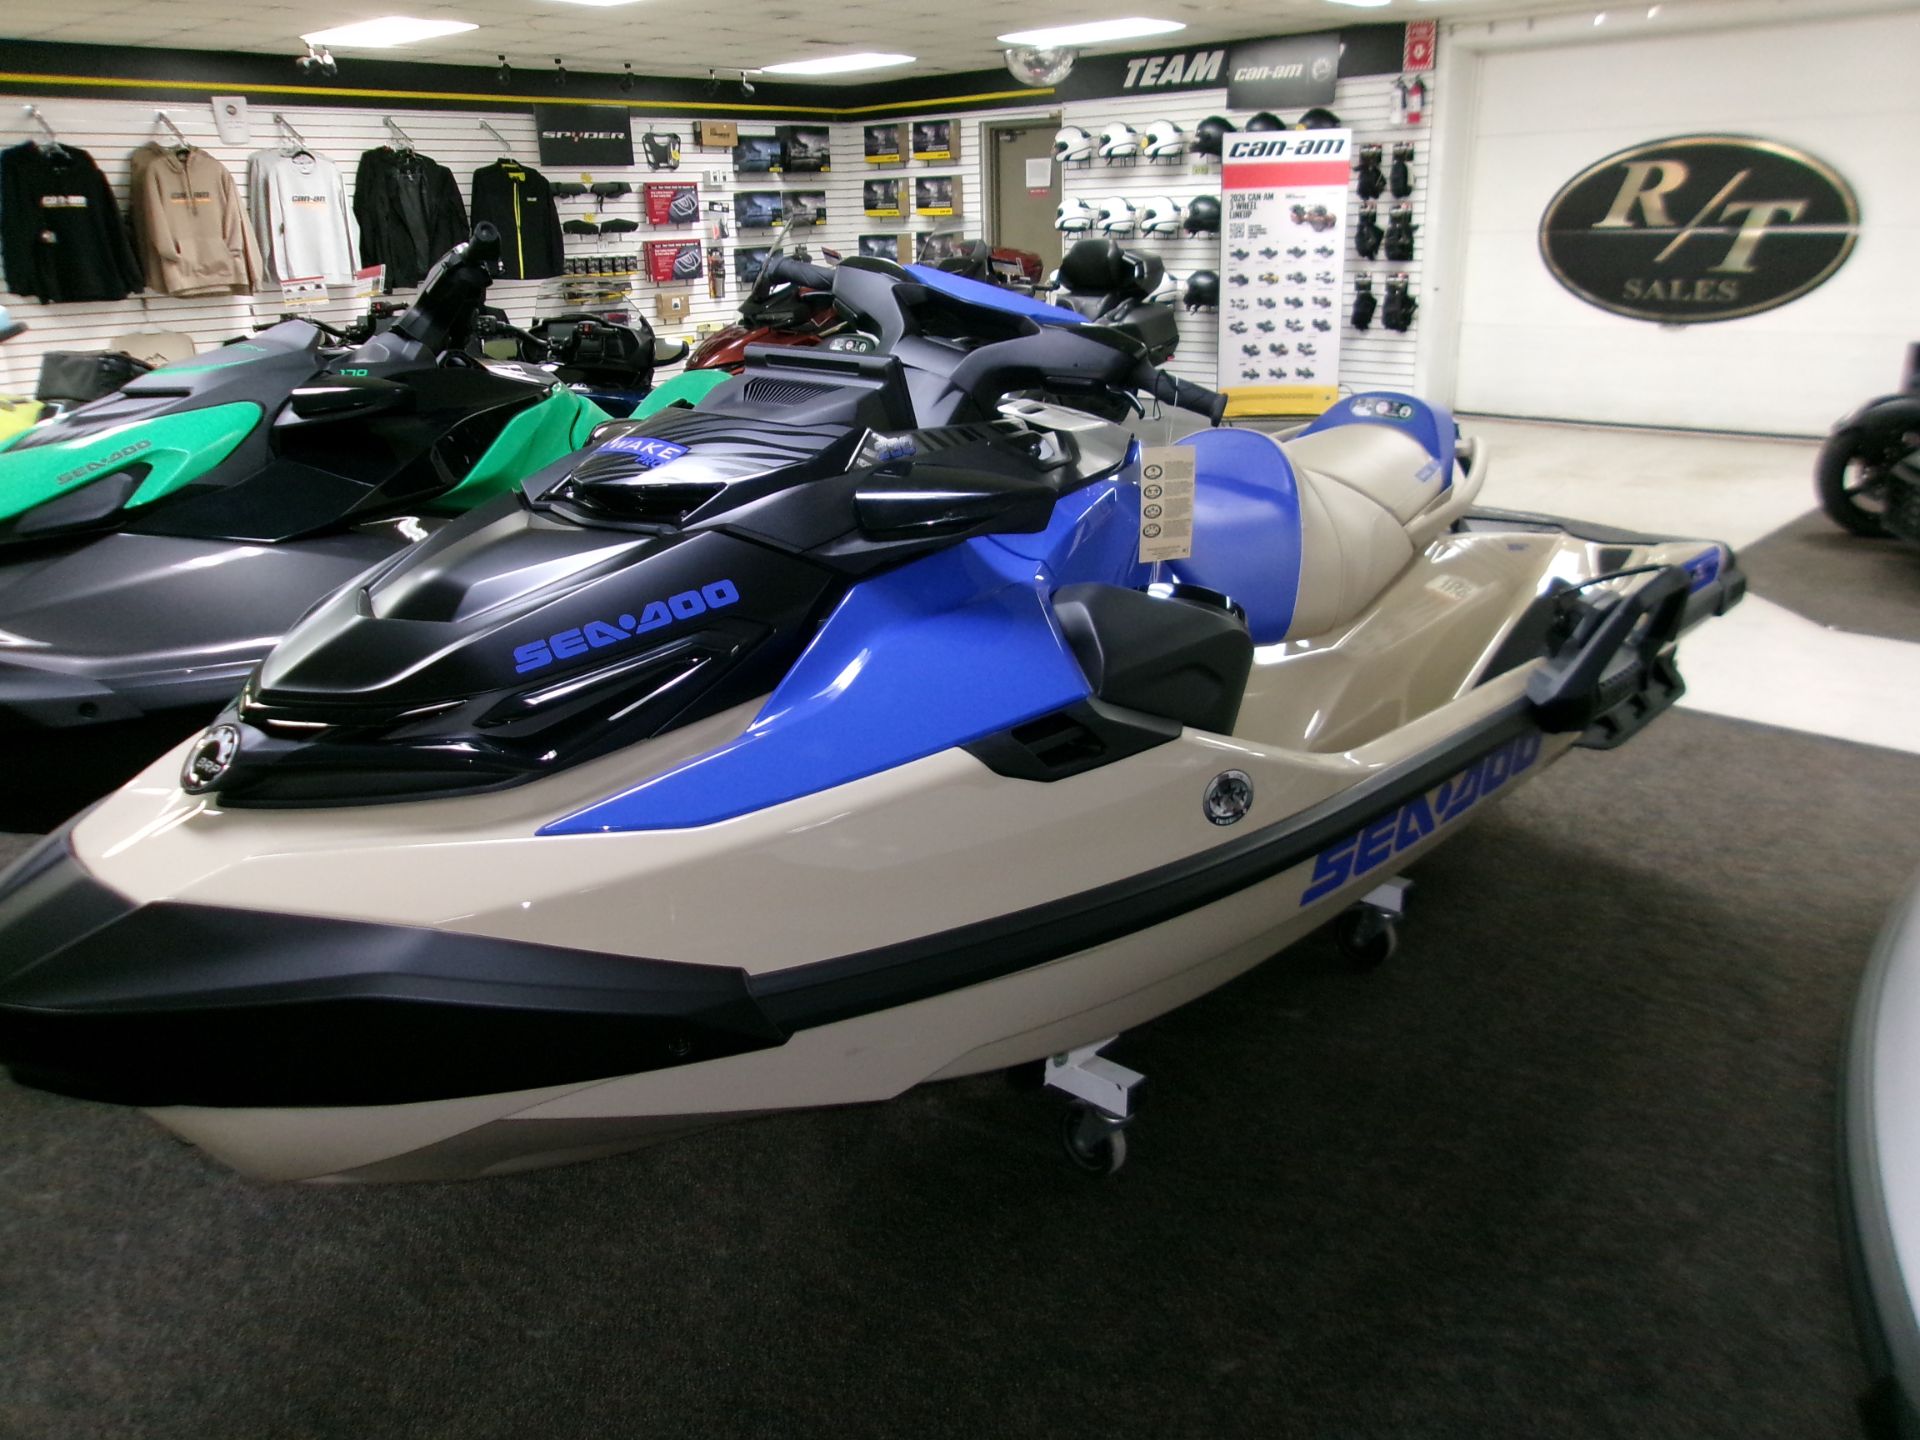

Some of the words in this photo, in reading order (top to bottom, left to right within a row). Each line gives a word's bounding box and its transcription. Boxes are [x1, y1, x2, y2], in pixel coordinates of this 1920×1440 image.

[1123, 50, 1225, 88] TEAM
[1234, 63, 1304, 81] can-am
[542, 131, 625, 143] SPYDER
[1228, 138, 1345, 158] can-am
[1591, 160, 1810, 274] R/T
[1622, 278, 1740, 302] SALES
[605, 438, 682, 460] WAKE
[196, 757, 222, 773] BRP
